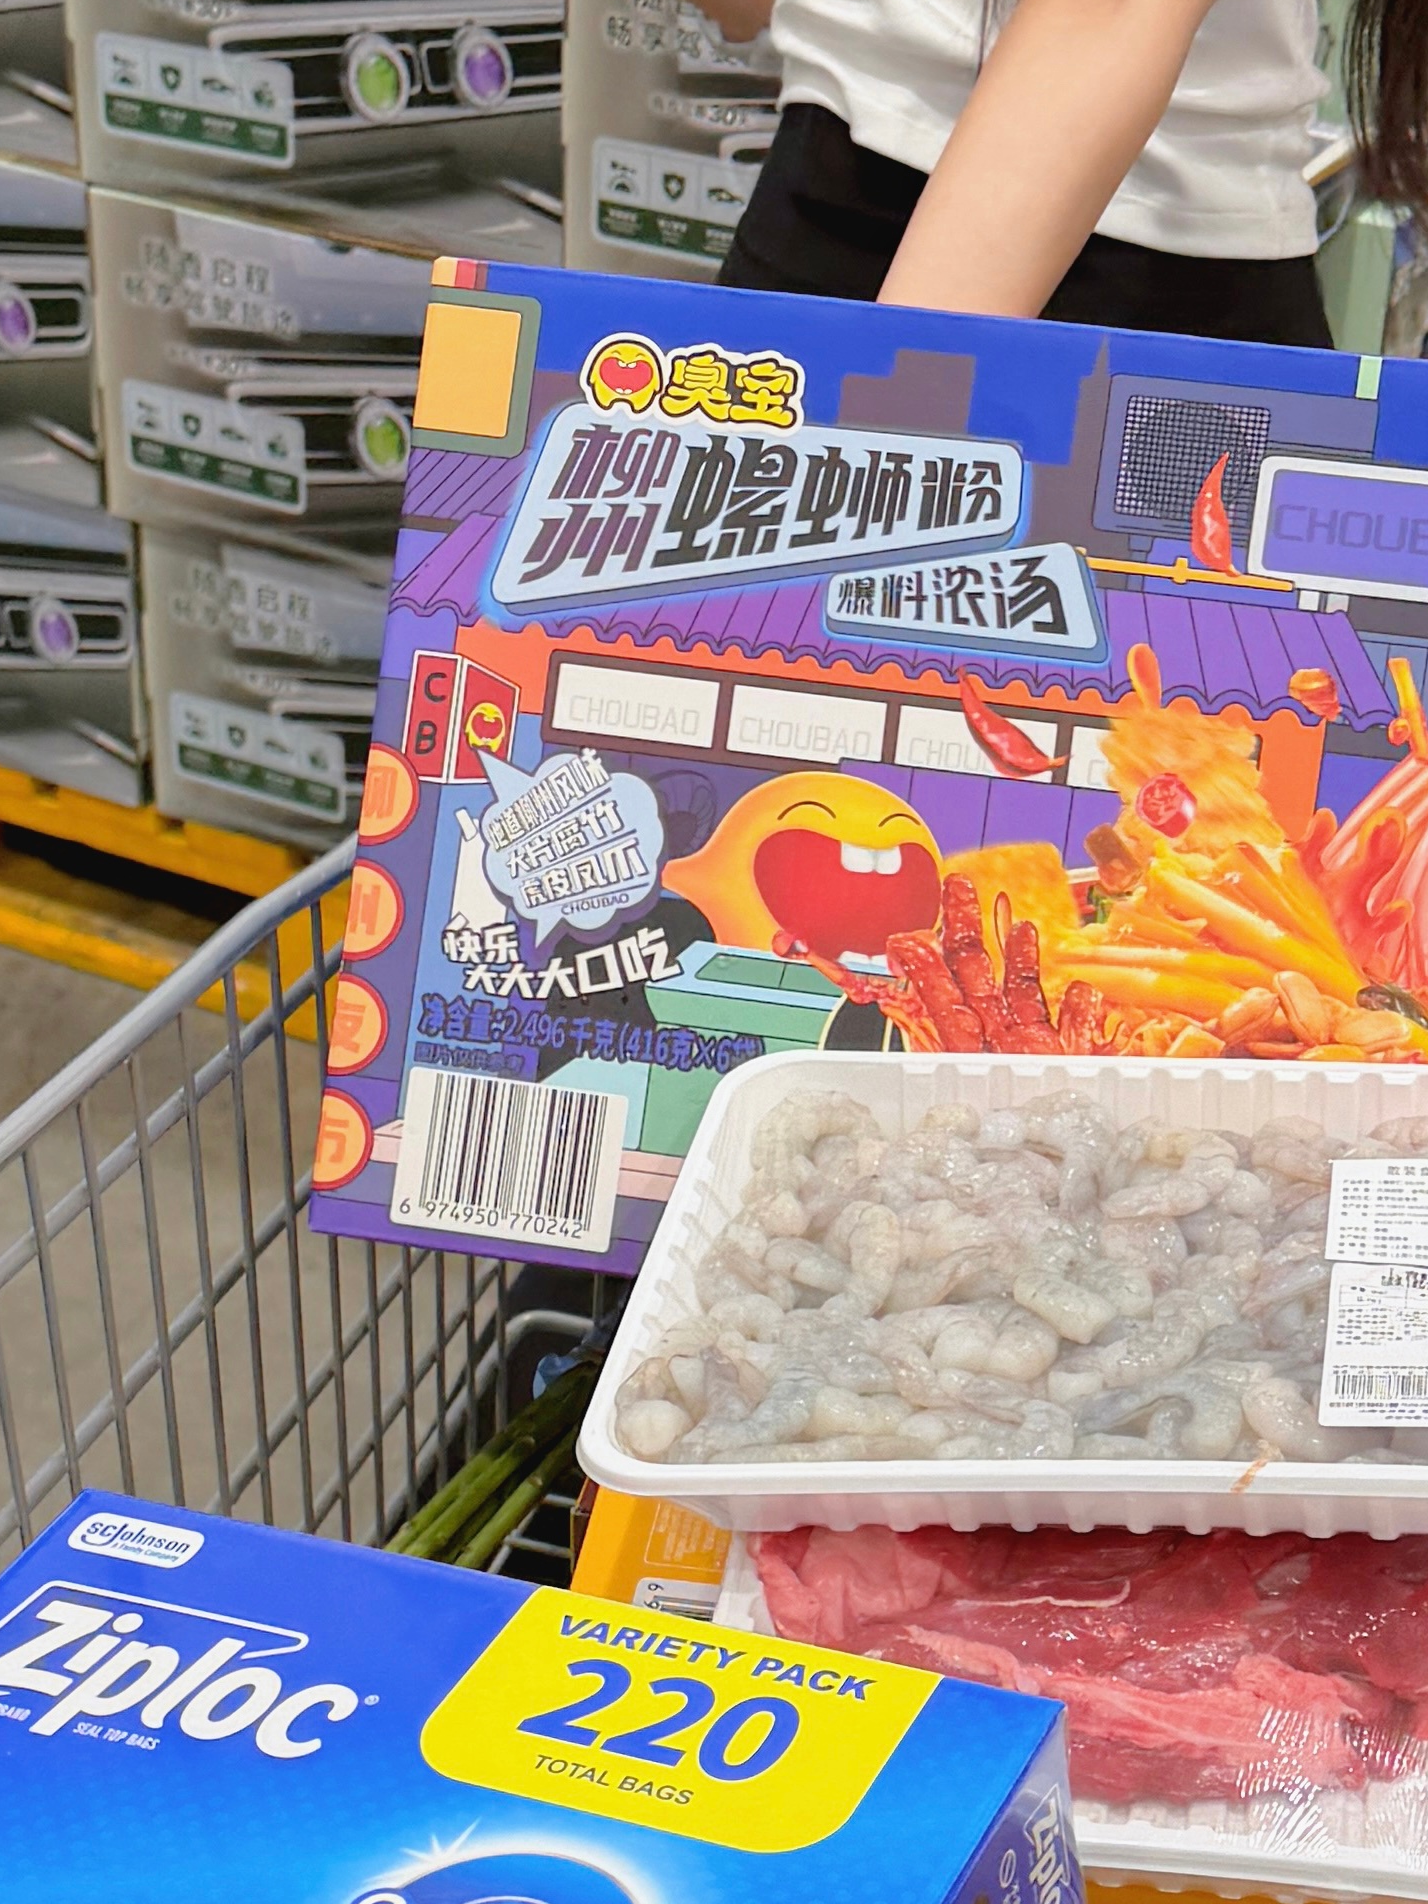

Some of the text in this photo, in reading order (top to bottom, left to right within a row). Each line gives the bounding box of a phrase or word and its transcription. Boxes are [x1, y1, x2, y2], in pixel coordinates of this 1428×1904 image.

[660, 350, 798, 428] 臭宝
[836, 554, 1069, 637] 爆料浓汤
[568, 696, 701, 737] CHOUBAO
[738, 716, 871, 758] CHOUBAO
[506, 799, 624, 879] 大片腐竹
[520, 837, 650, 908] 虎皮凤爪
[560, 893, 630, 916] CHOUBAO
[442, 921, 519, 964] 快乐
[462, 926, 685, 999] 大大大口吃
[398, 1198, 583, 1241] 6 974950 770242
[559, 1614, 876, 1701] VARIETY PACK
[517, 1659, 800, 1782] 220
[534, 1754, 694, 1805] TOTAL BAGS
